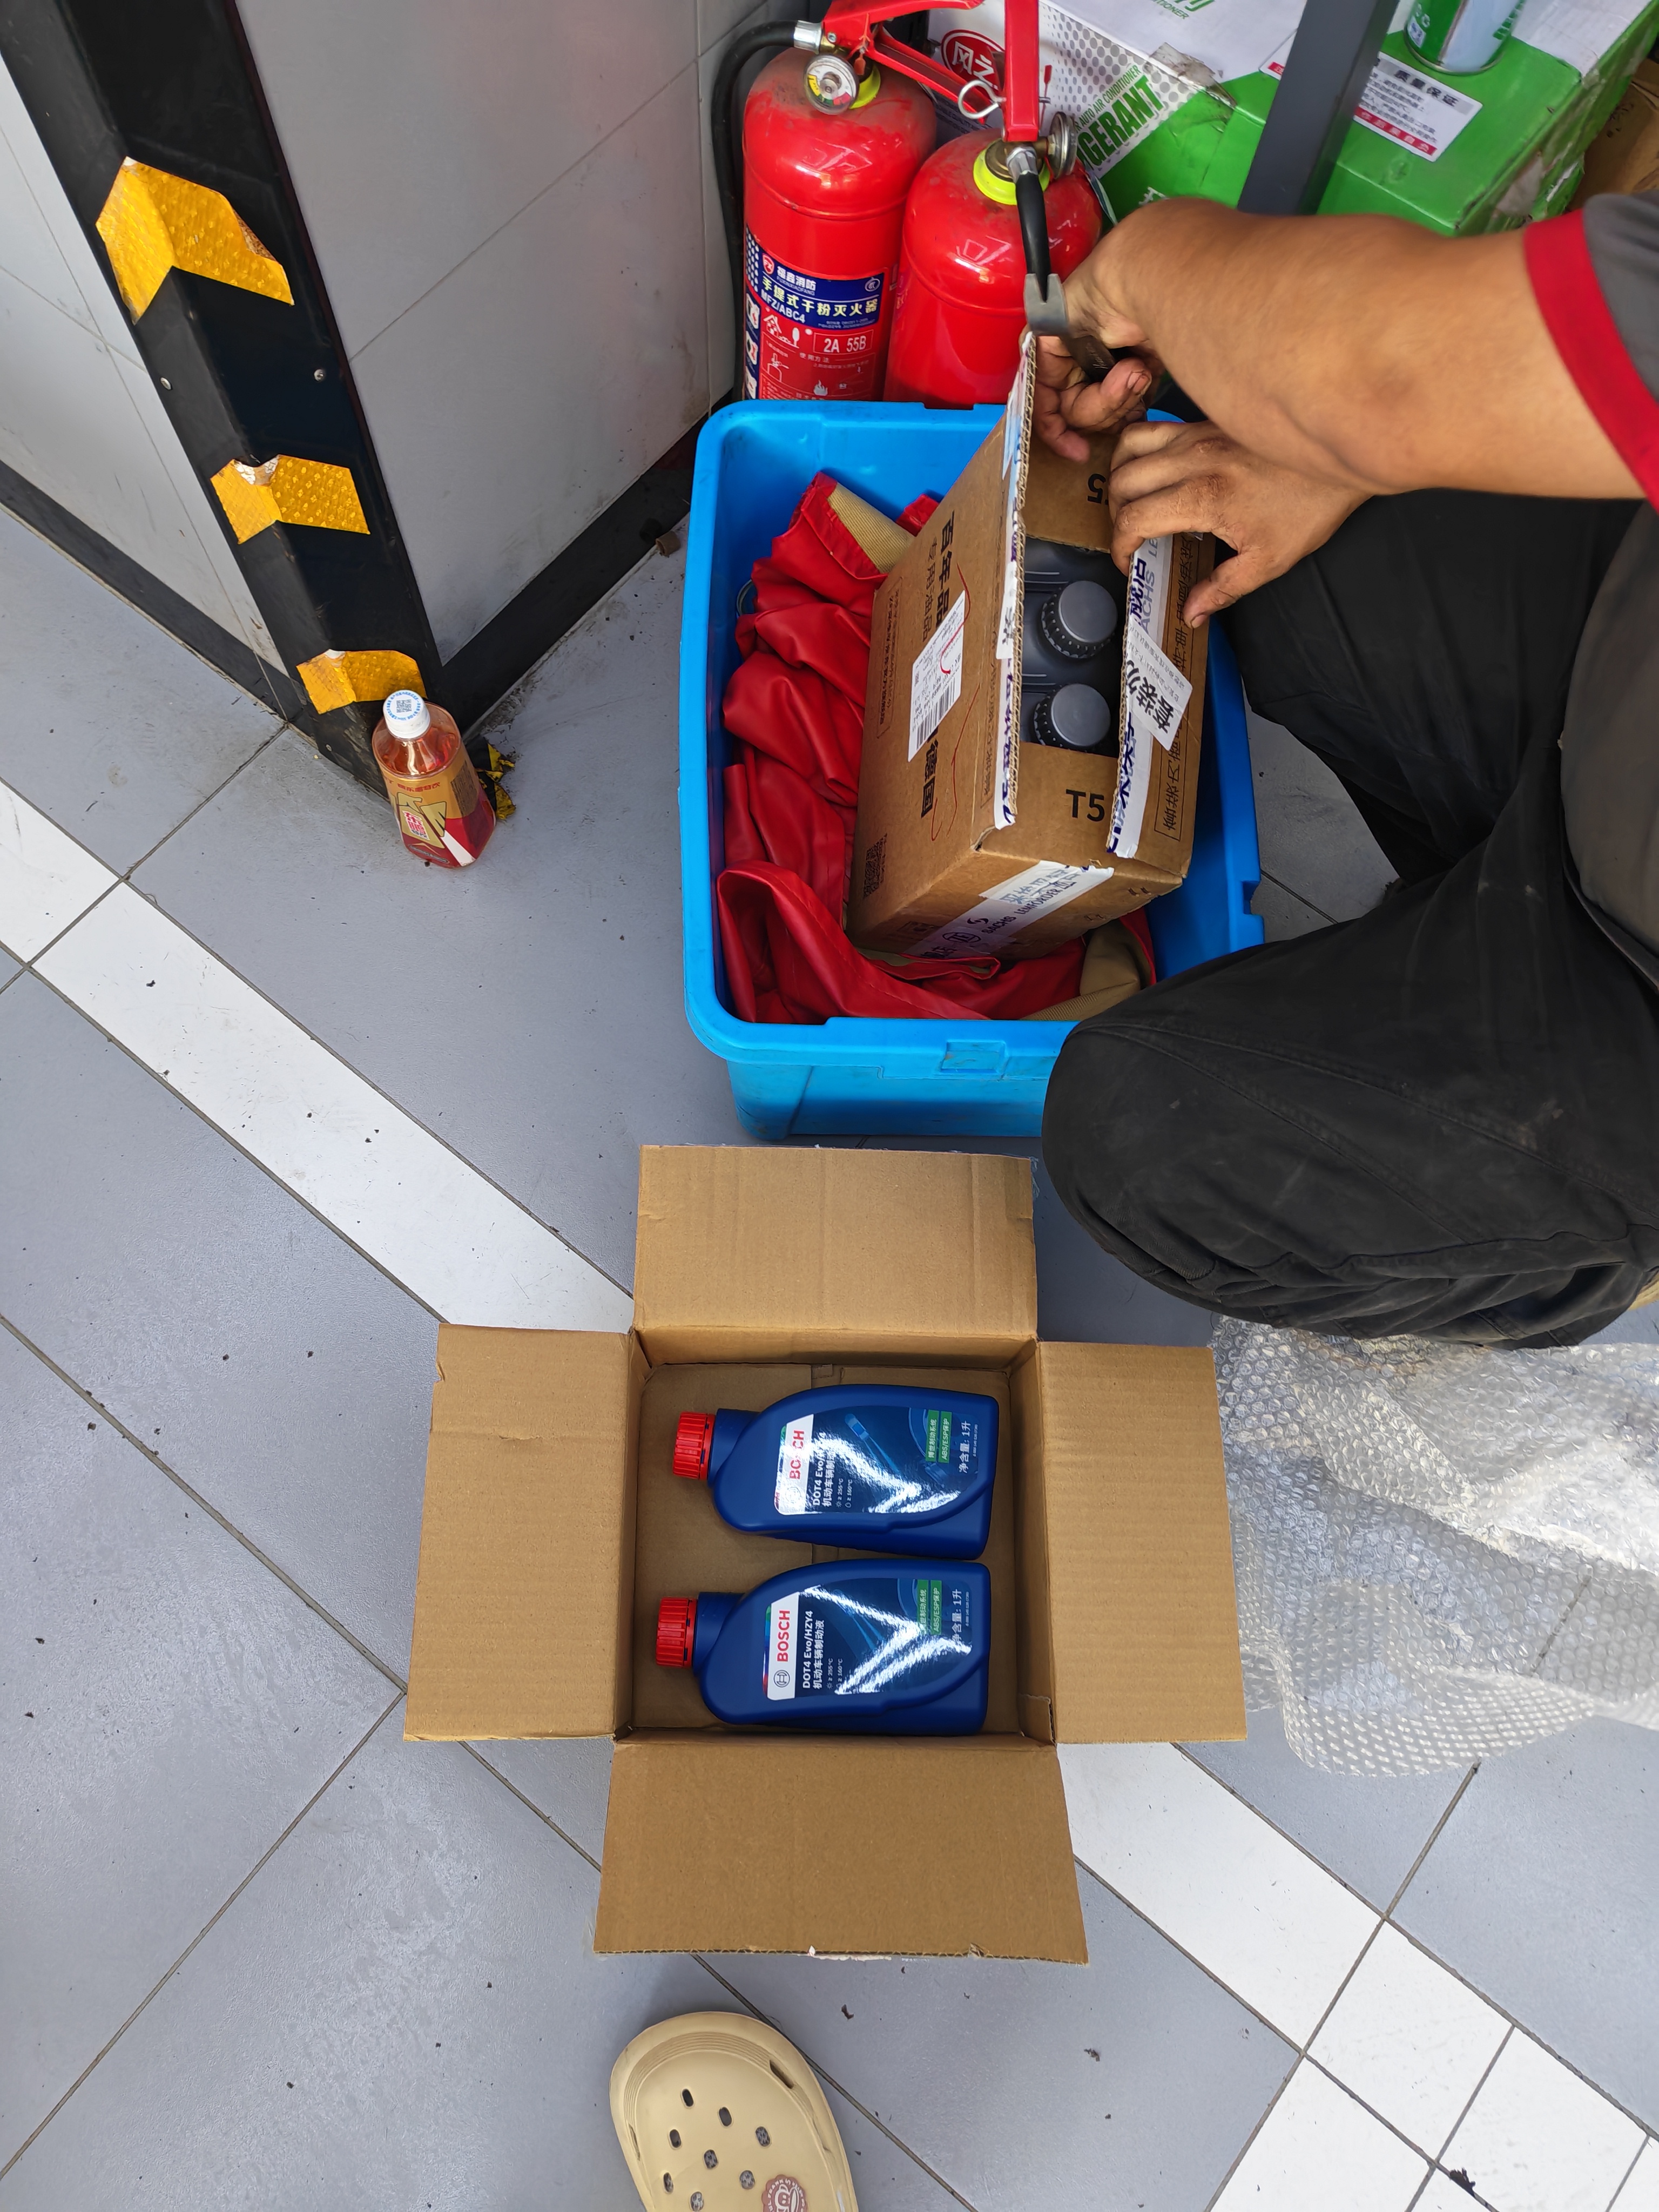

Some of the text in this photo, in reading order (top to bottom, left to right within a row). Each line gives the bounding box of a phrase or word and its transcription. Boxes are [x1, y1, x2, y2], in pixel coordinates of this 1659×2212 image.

[1078, 108, 1095, 127] AUTO
[1094, 99, 1106, 114] AIR
[1103, 64, 1142, 103] CONDITIONER
[762, 275, 878, 317] 手提式干粉灭火器
[824, 335, 866, 353] 2A 55B
[1087, 474, 1109, 504] 5
[922, 536, 938, 642] 专用油品
[1139, 570, 1156, 637] ACHS
[1065, 788, 1106, 822] T5
[981, 916, 1017, 934] SACHS
[942, 1418, 950, 1460] ABS/ESP保护
[961, 1420, 971, 1437] 1升
[789, 1430, 805, 1480] BOCH
[813, 1479, 822, 1506] DOT4
[952, 1589, 962, 1606] 1升
[777, 1610, 790, 1662] BOSCH
[802, 1610, 813, 1689] DOT4 Evo/HZY4
[813, 1620, 825, 1689] 机动车辆制动液
